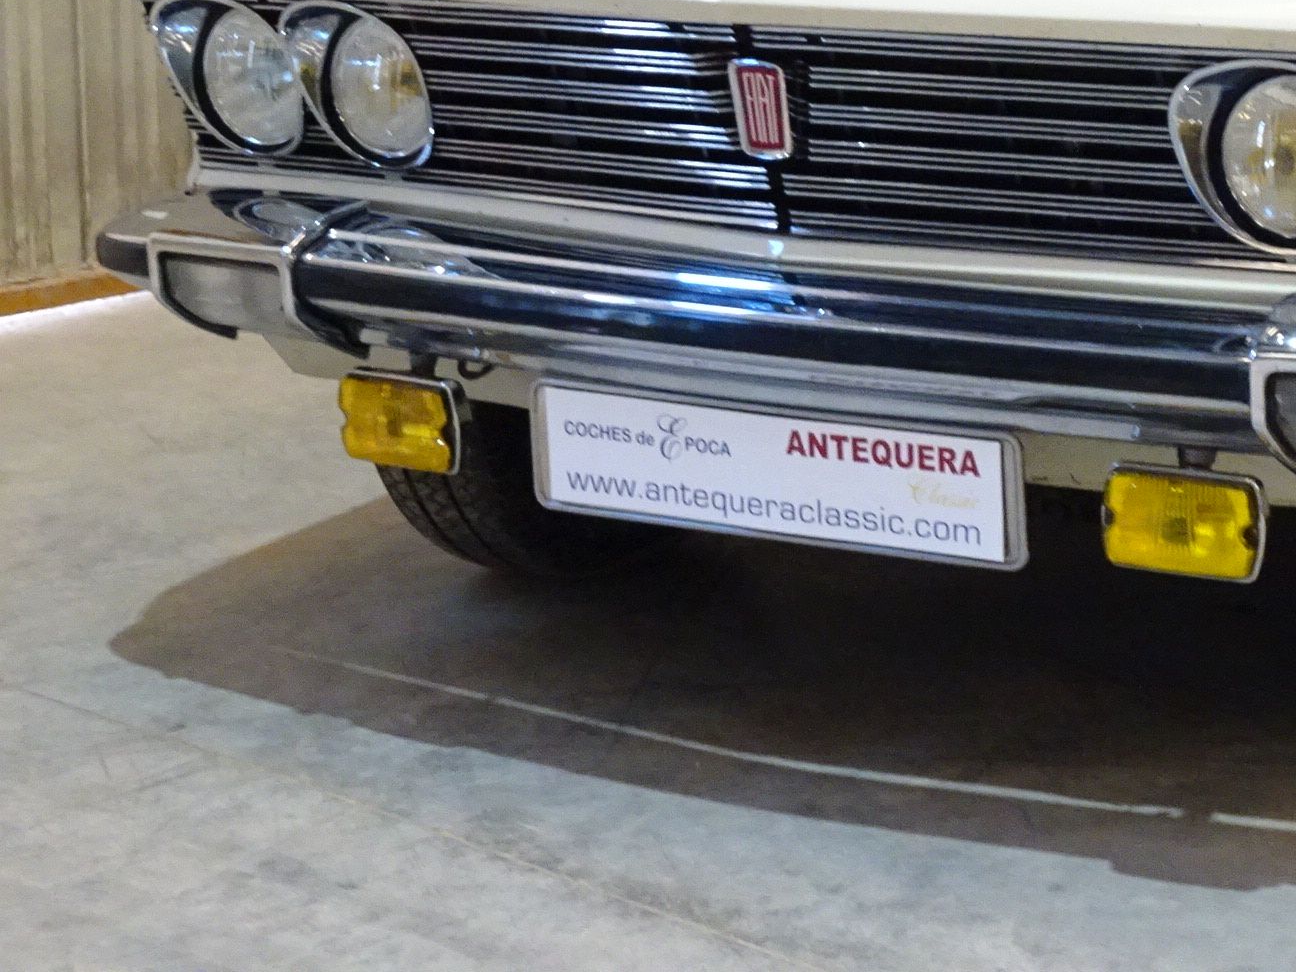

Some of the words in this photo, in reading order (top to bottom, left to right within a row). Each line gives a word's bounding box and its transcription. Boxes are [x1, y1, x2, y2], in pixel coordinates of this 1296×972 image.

[741, 72, 780, 144] FIAT
[563, 419, 632, 443] COCHES
[635, 431, 656, 447] de
[786, 429, 981, 478] ANTEQUERA
[566, 470, 982, 546] www.antequeraclassic.com
